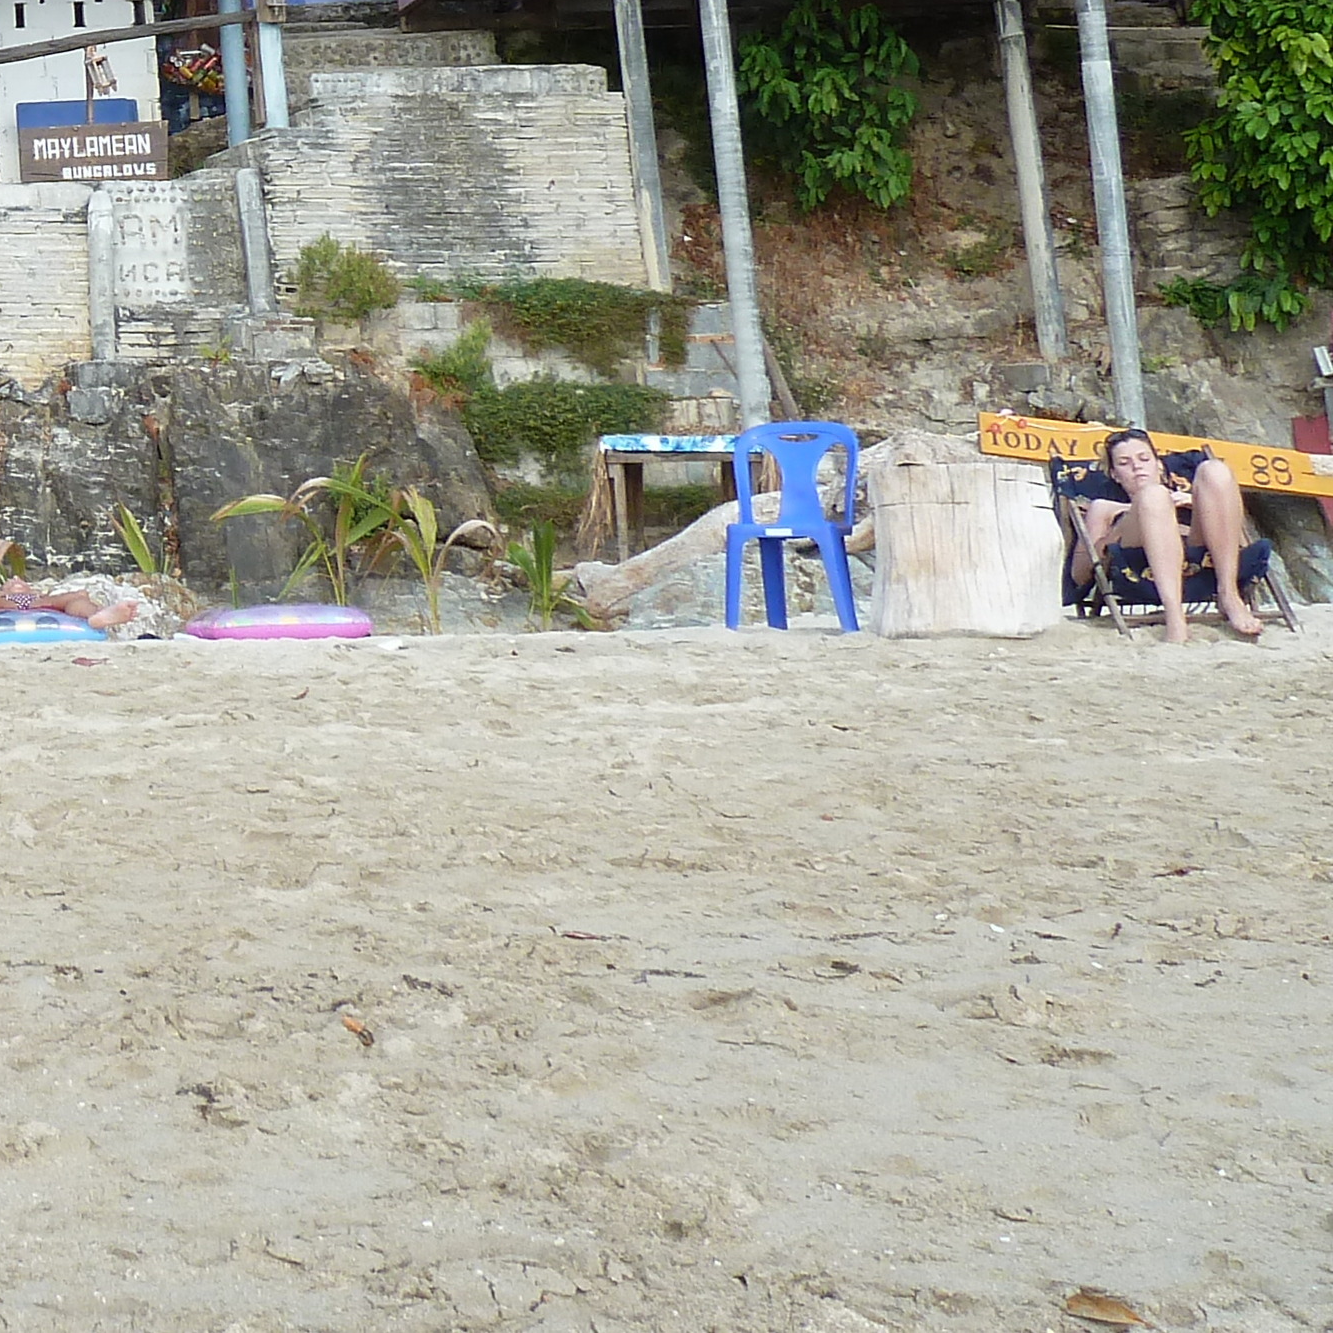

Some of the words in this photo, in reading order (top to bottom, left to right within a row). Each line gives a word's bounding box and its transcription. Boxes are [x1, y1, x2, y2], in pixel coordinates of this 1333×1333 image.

[33, 133, 151, 161] MAYLAMEAN
[62, 162, 157, 180] BUNGALOWS
[985, 429, 1078, 456] TODAY
